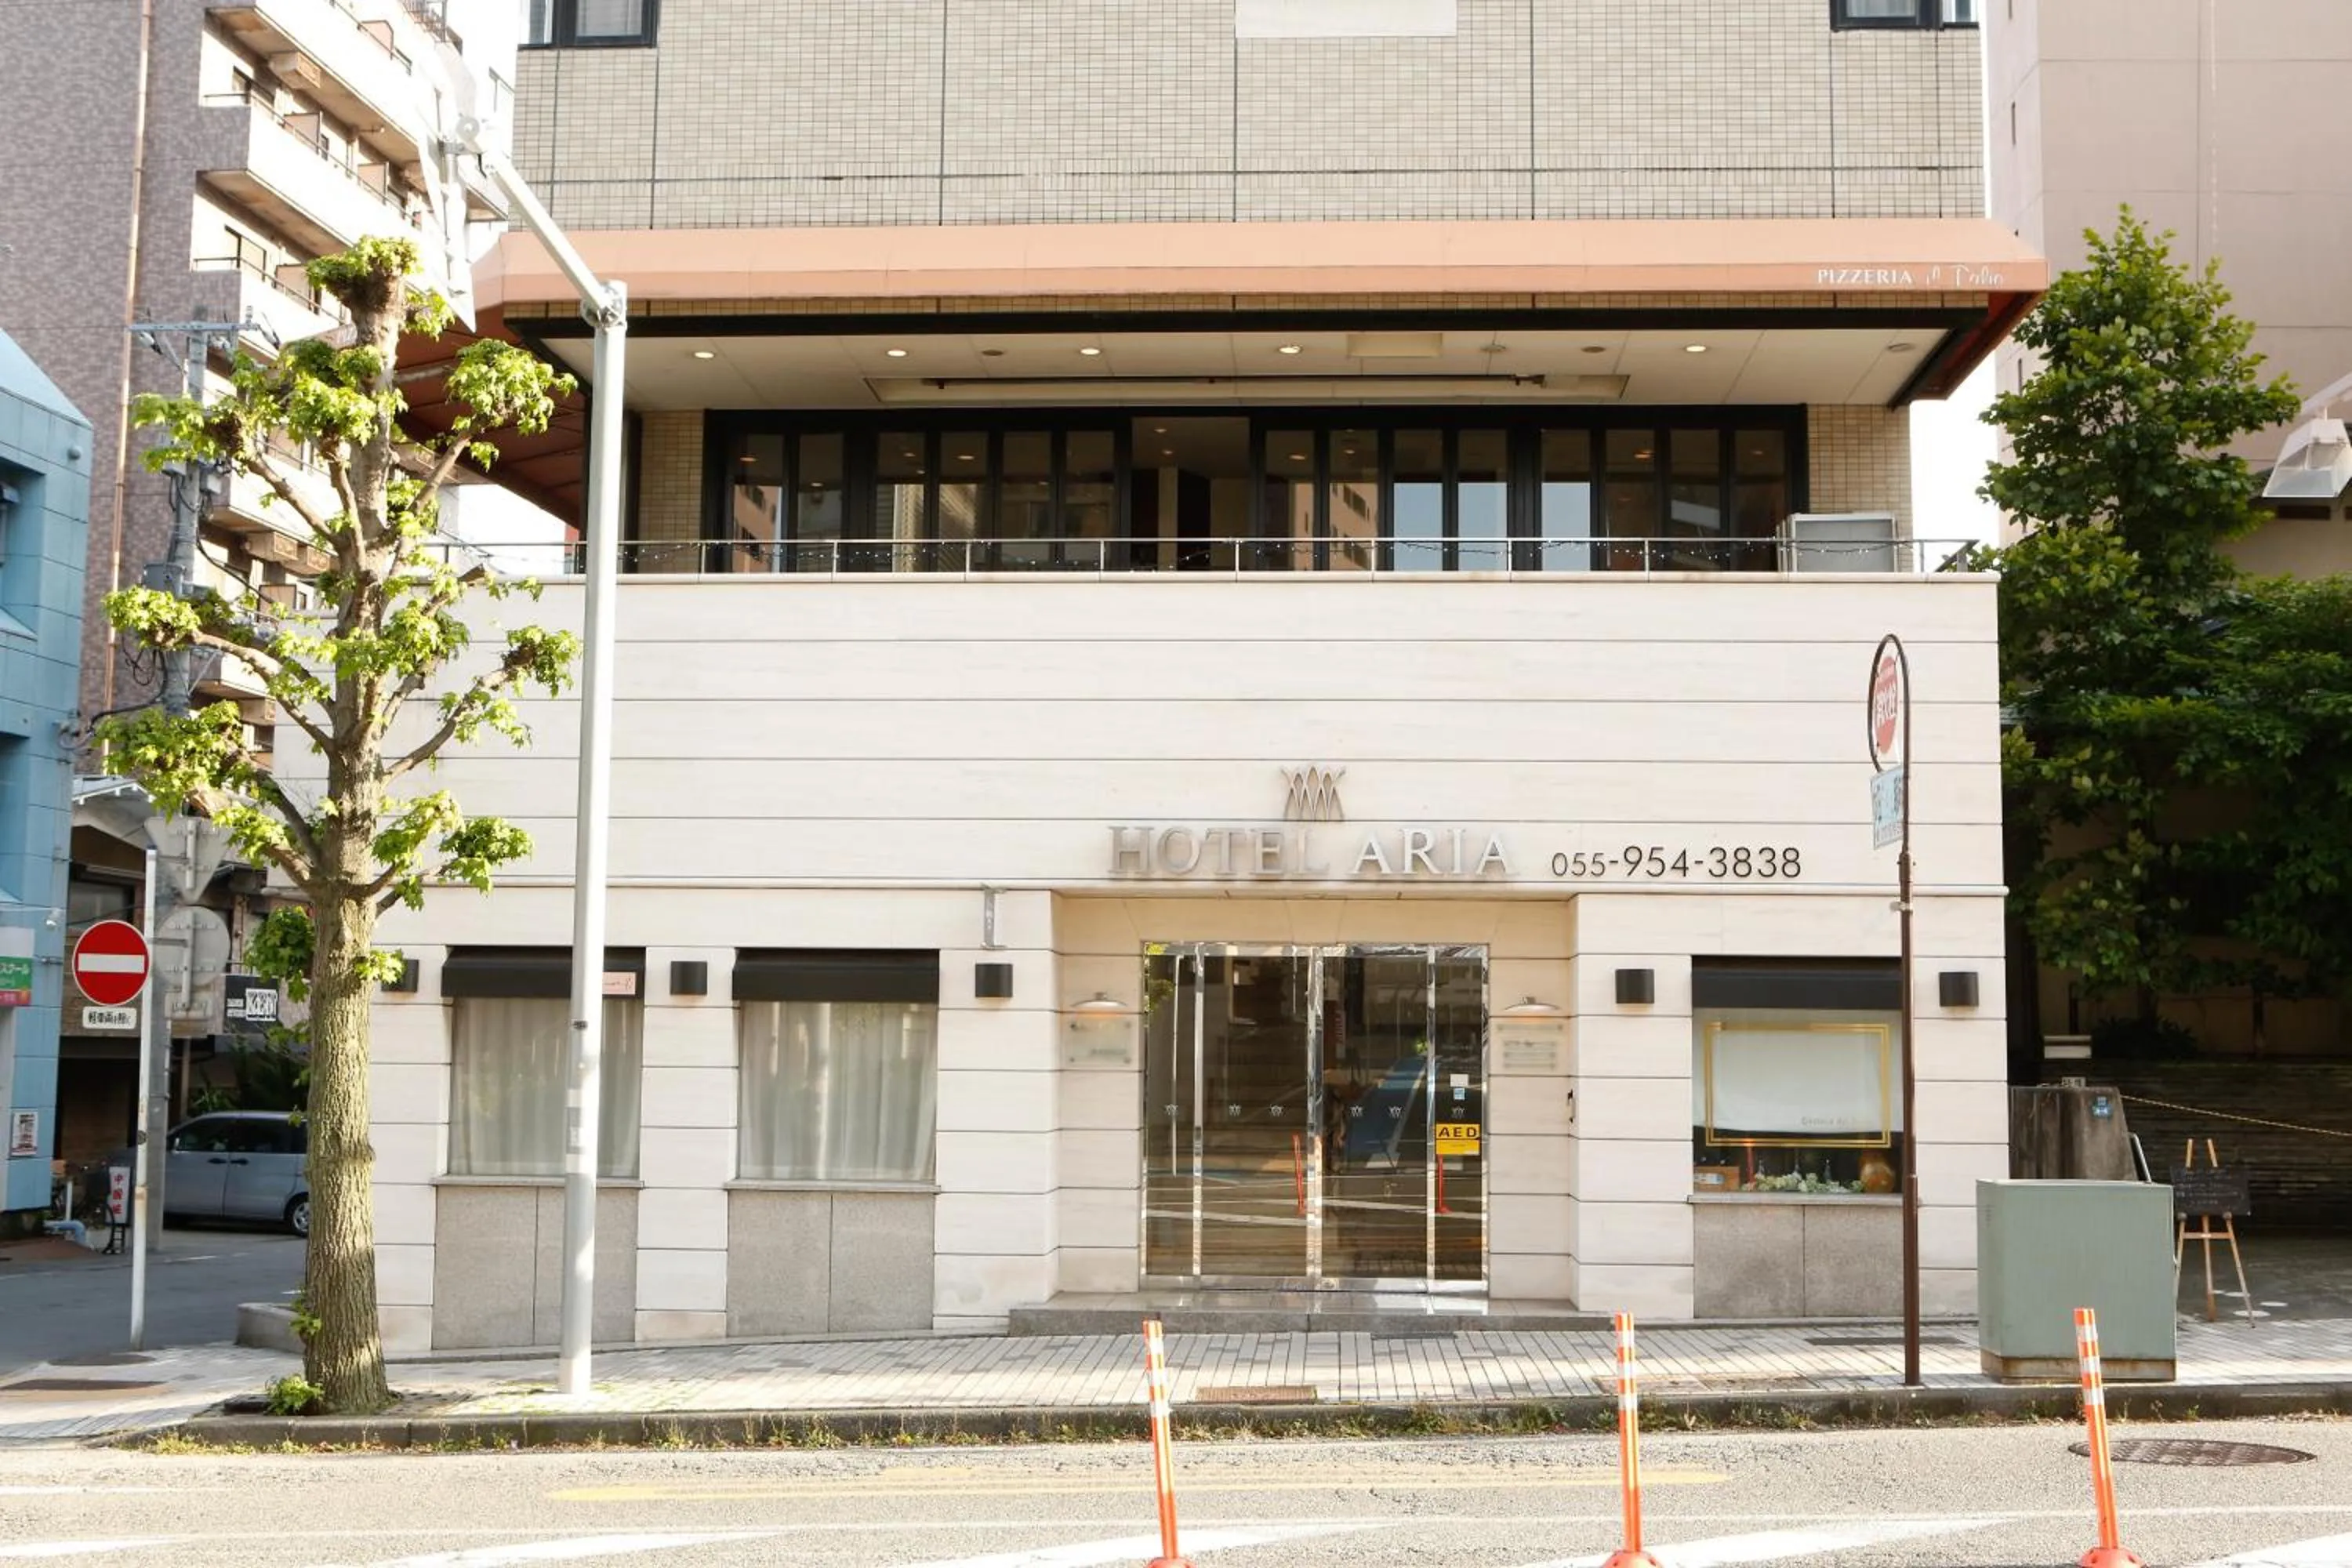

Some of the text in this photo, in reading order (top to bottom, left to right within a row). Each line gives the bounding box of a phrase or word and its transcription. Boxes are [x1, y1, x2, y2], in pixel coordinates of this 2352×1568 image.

[1817, 269, 1913, 285] PIZZERIA
[1106, 826, 1519, 875] HOTEL ARIA
[1552, 845, 1801, 877] 055-954-3838
[1439, 1127, 1477, 1138] AED
